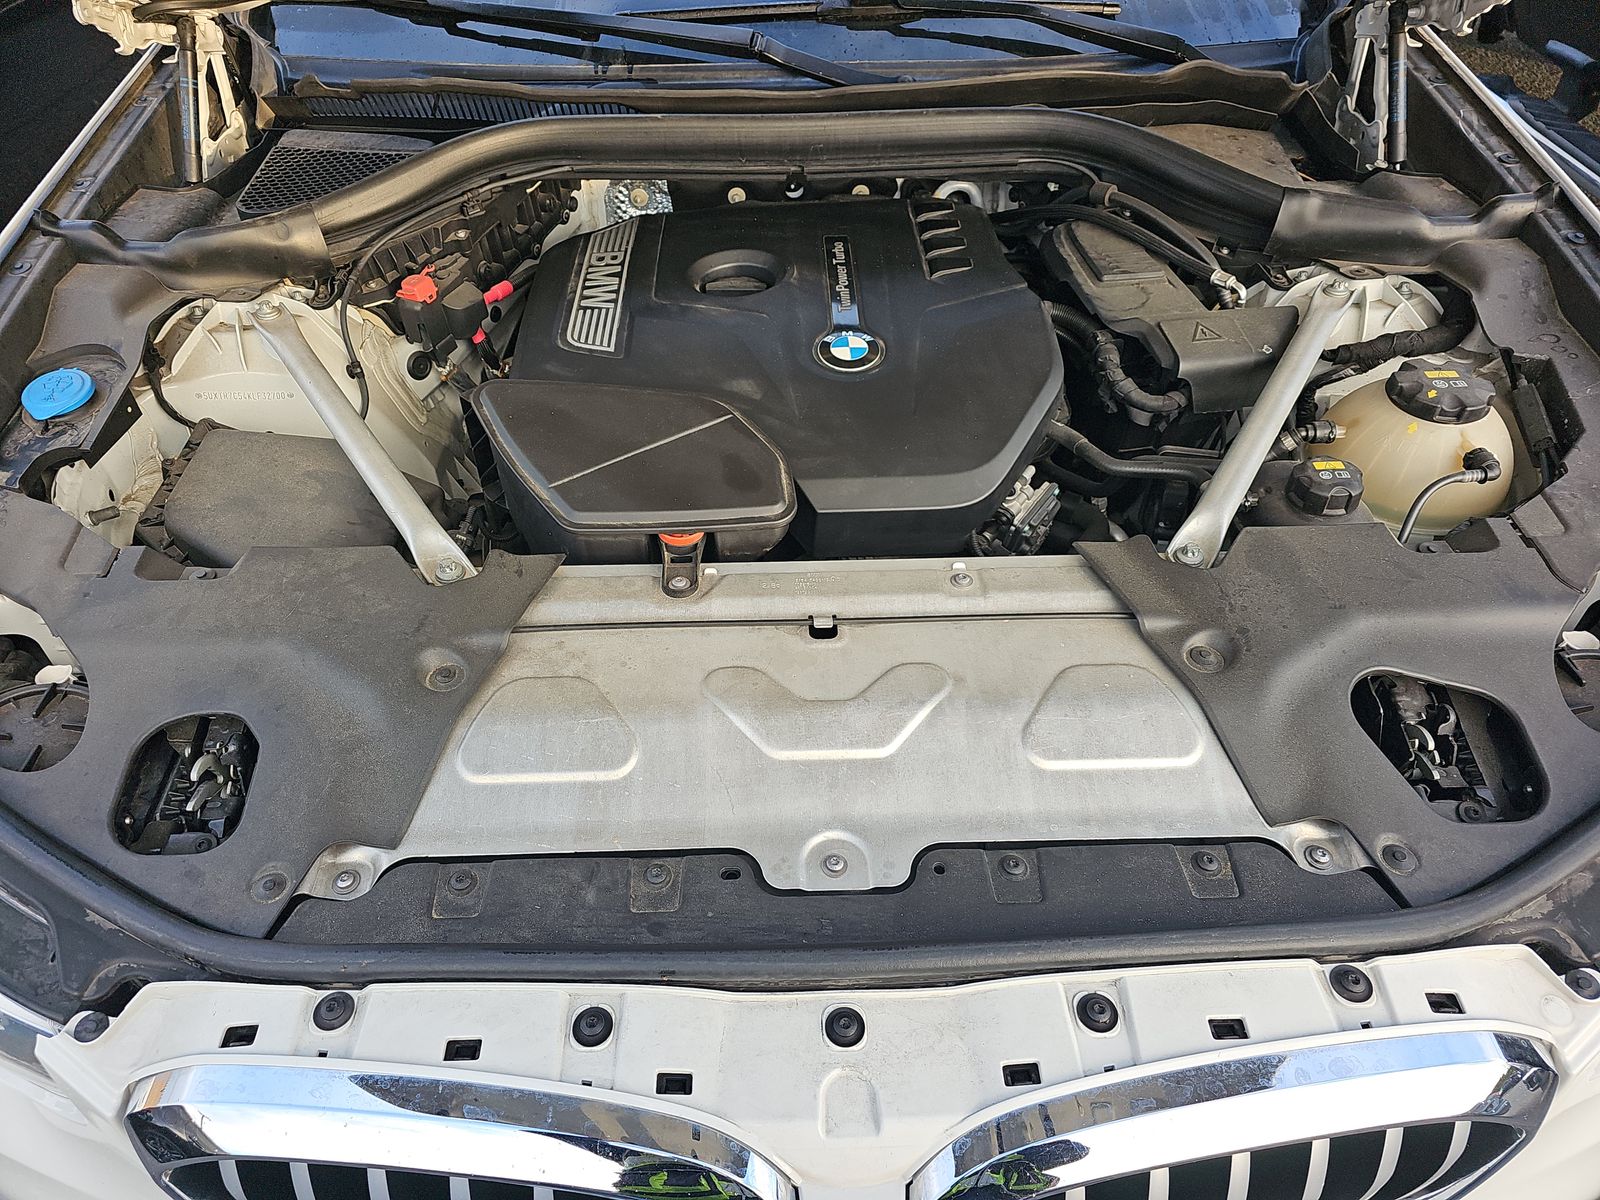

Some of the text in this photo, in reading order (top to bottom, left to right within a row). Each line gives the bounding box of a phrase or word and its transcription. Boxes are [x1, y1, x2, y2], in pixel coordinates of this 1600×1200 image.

[580, 251, 625, 308] BMW
[832, 241, 852, 312] TwinPower Turbo
[823, 330, 875, 343] BMW
